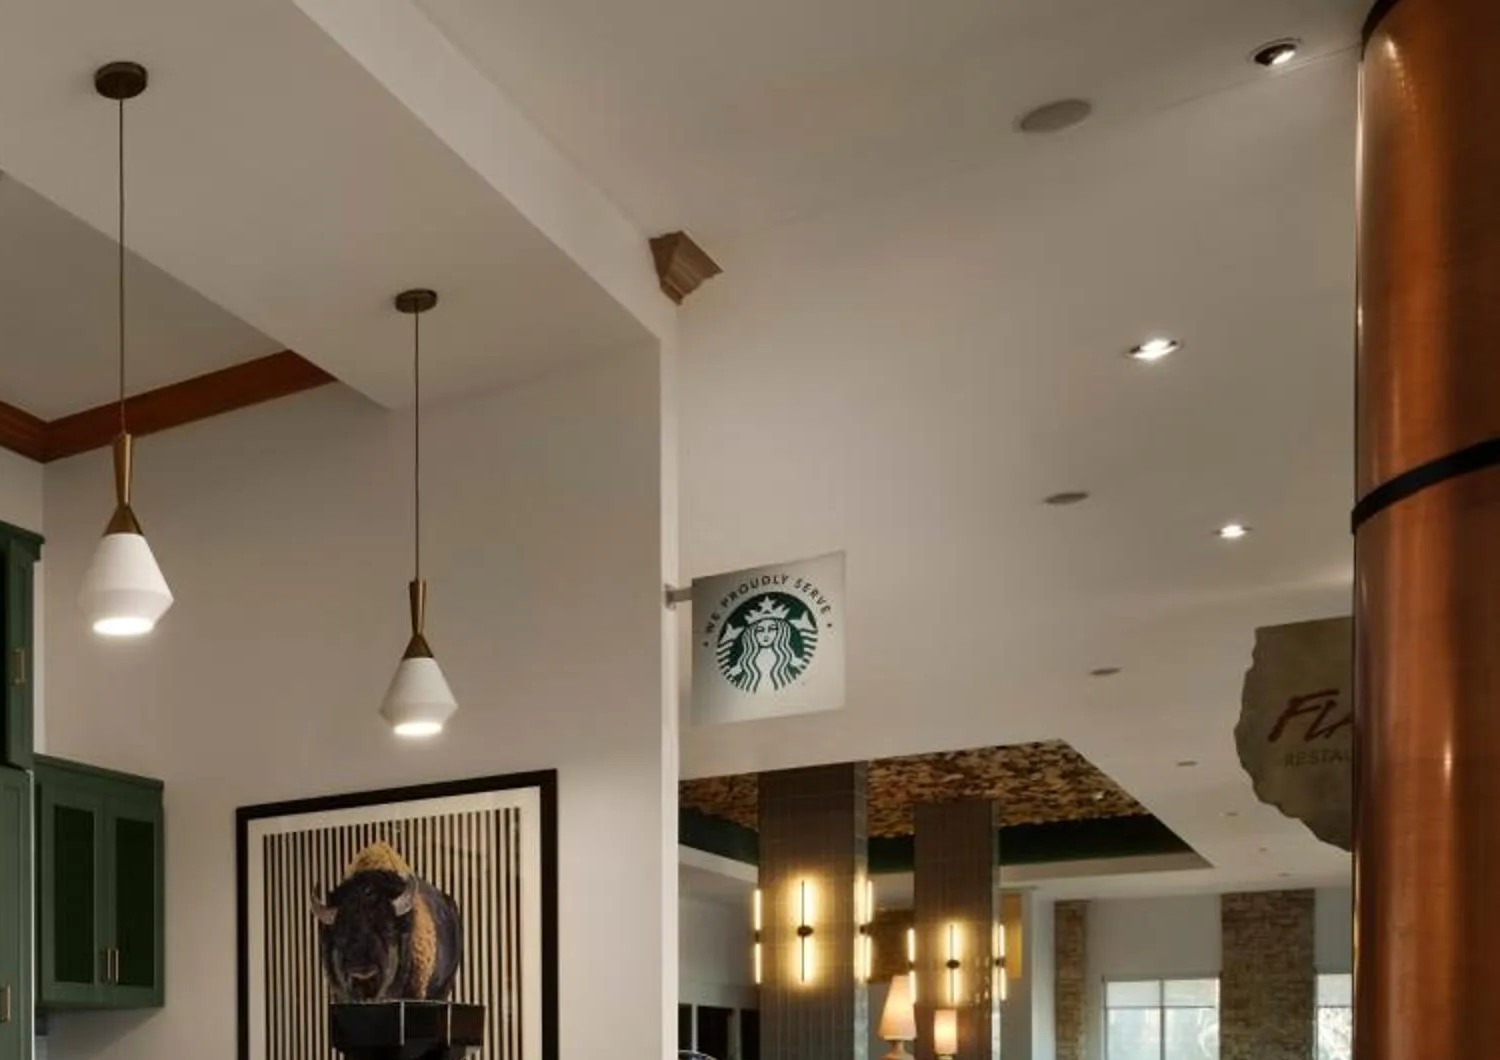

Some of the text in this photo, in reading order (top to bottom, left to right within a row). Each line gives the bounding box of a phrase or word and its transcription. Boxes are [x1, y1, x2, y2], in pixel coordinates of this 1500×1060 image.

[705, 574, 832, 634] WE PROUDLY SERVE
